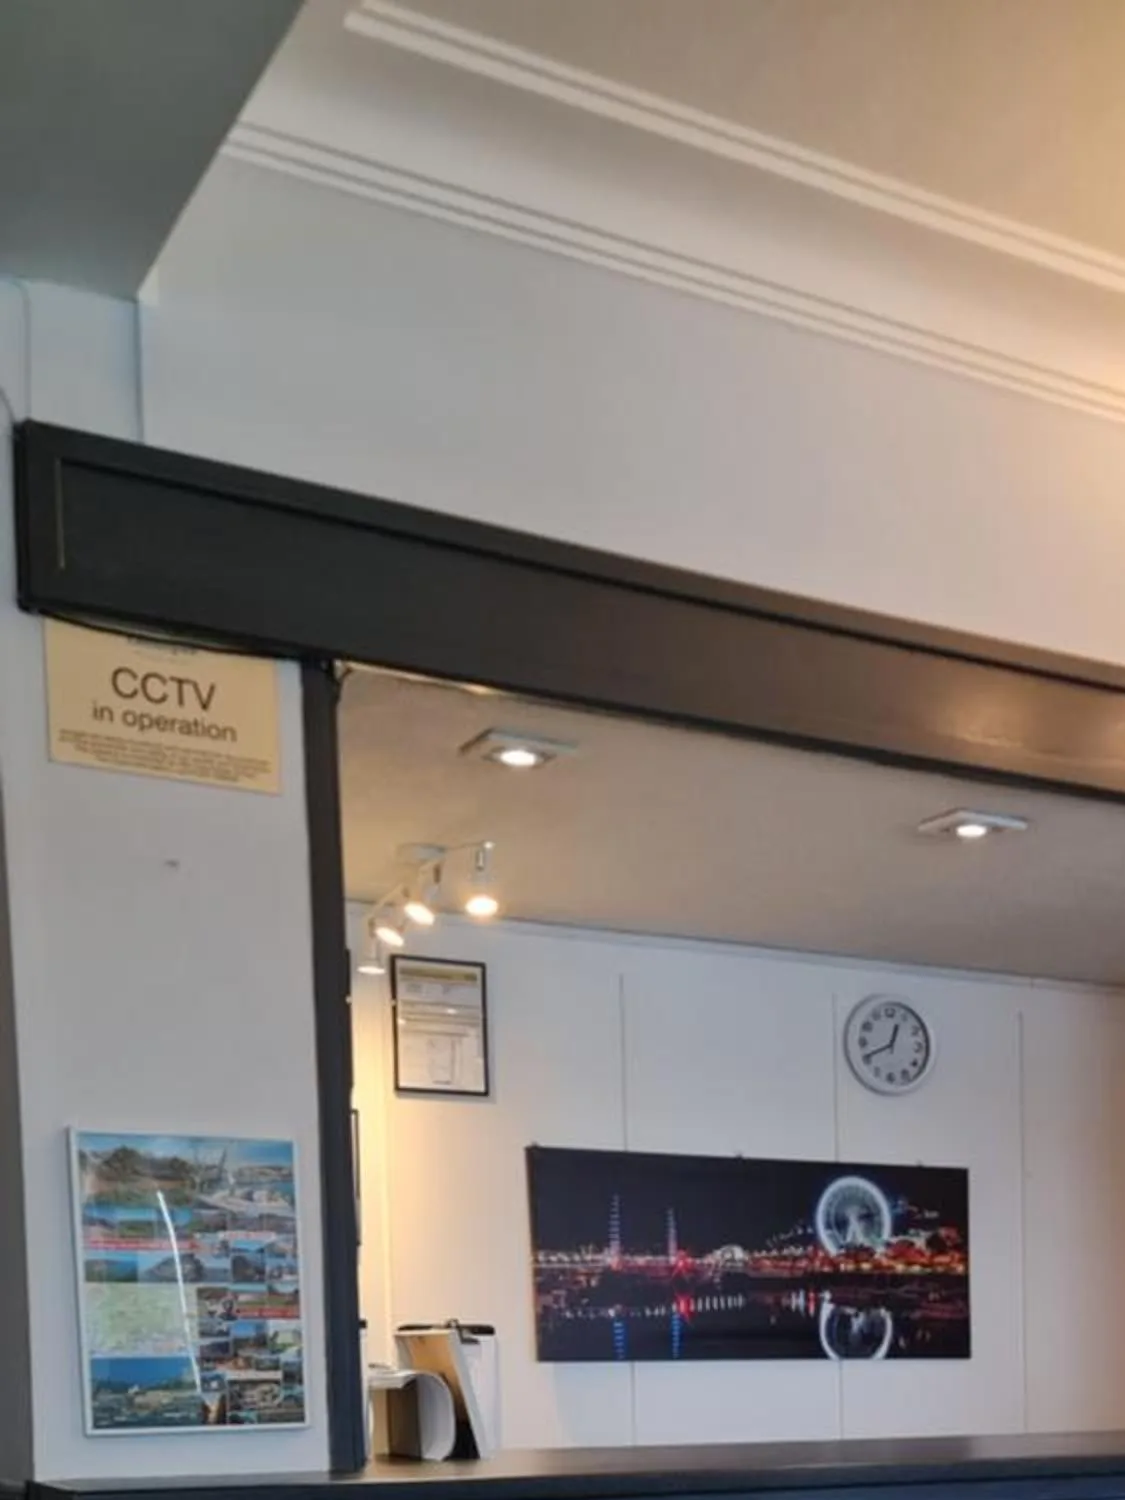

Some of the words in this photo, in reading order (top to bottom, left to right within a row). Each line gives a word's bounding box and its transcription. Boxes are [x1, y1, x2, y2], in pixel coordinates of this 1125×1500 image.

[111, 666, 216, 711] CCTV
[93, 700, 114, 723] in
[121, 710, 238, 743] operation
